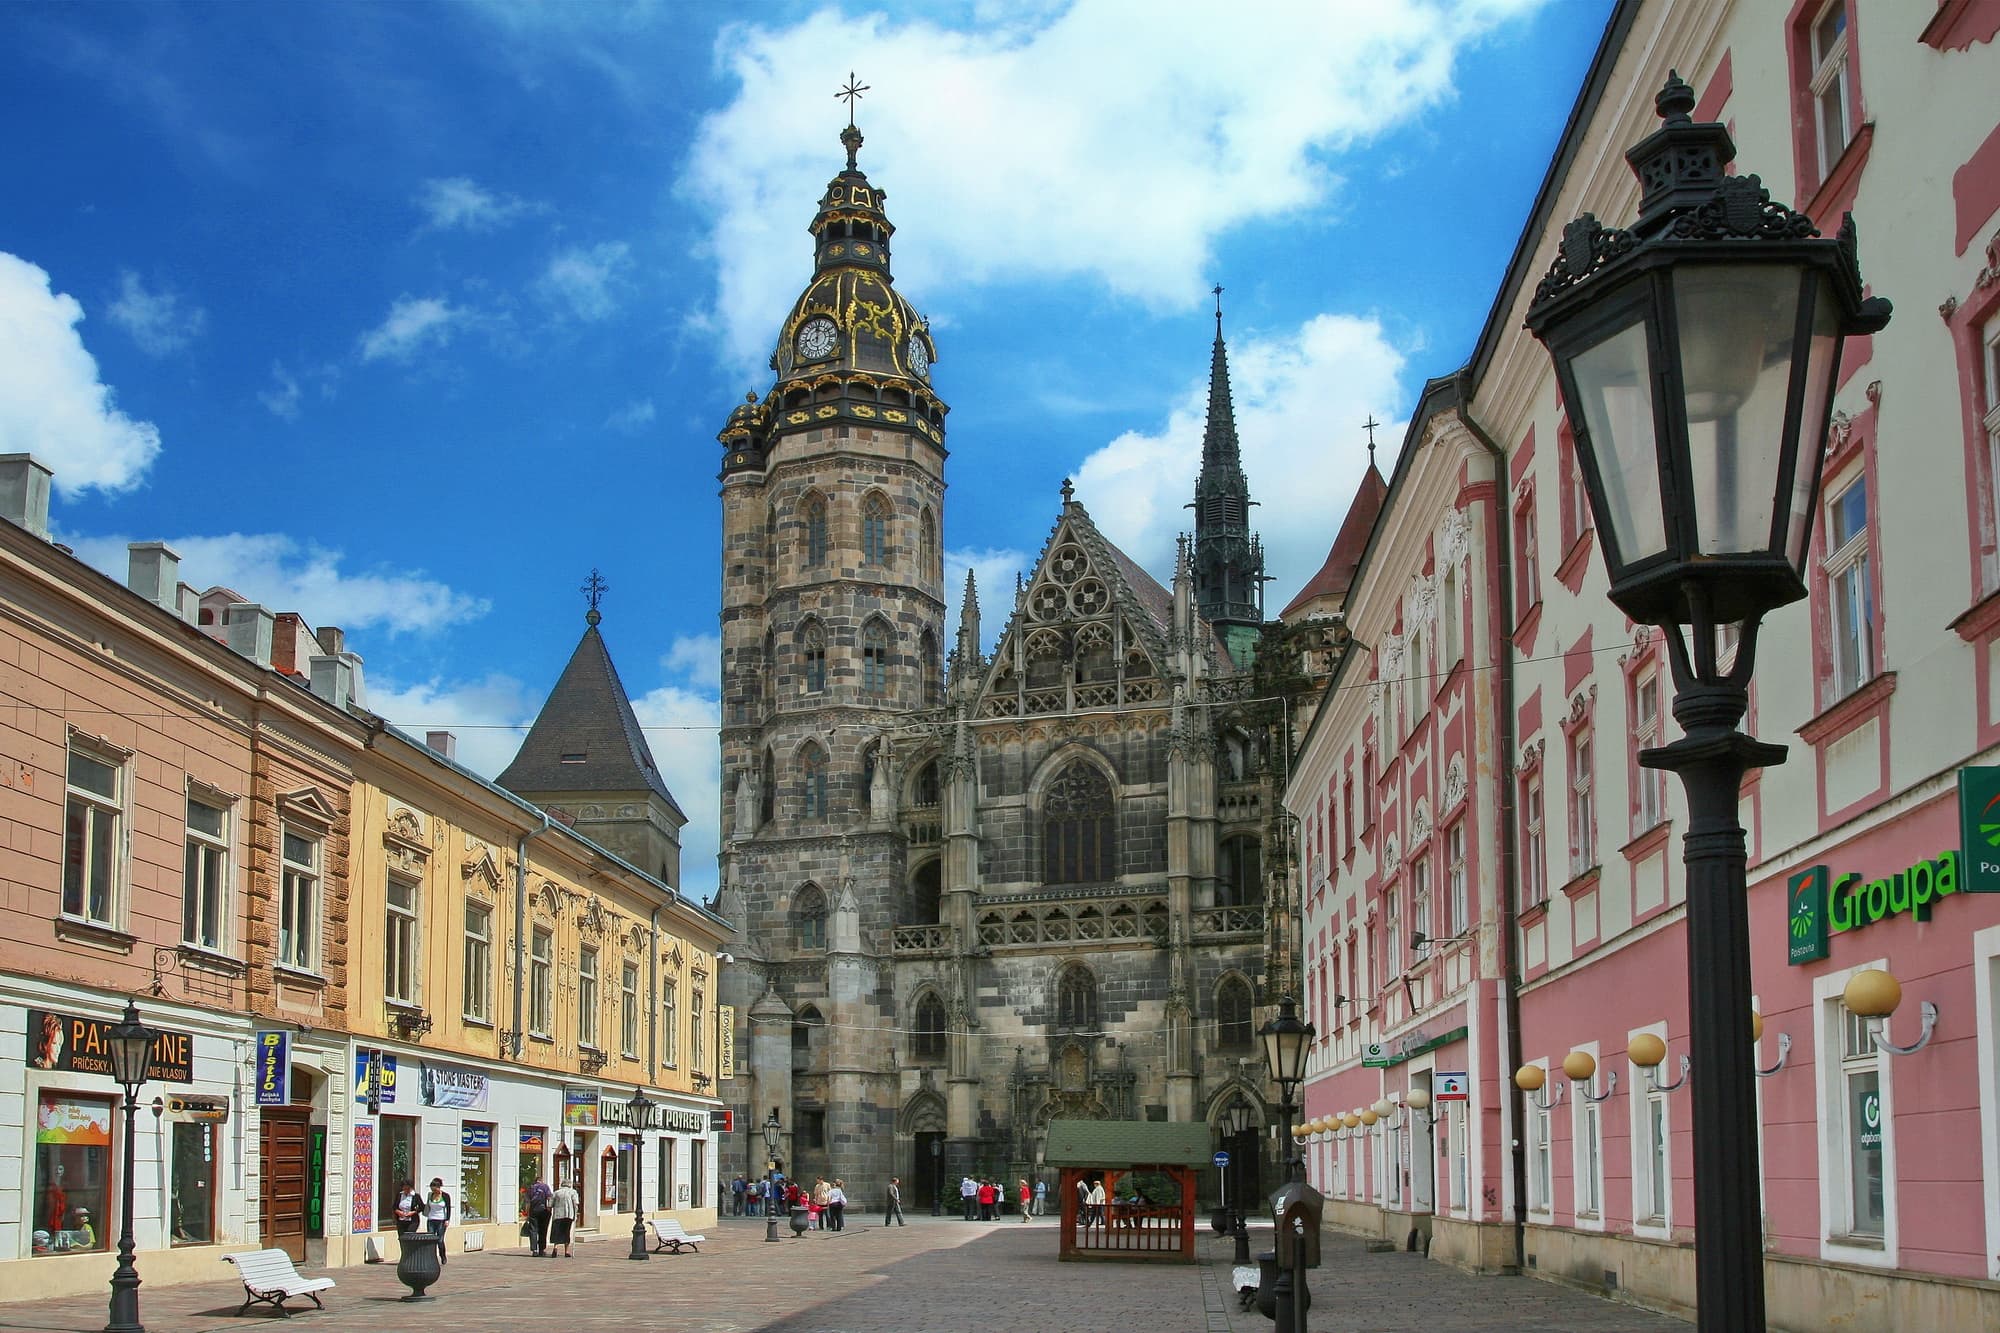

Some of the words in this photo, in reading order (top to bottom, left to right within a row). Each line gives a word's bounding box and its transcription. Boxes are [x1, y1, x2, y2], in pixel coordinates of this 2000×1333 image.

[263, 1033, 280, 1091] Bistro
[436, 1069, 456, 1086] STONE
[457, 1072, 484, 1090] MASTERS
[311, 1133, 322, 1230] TATTOO
